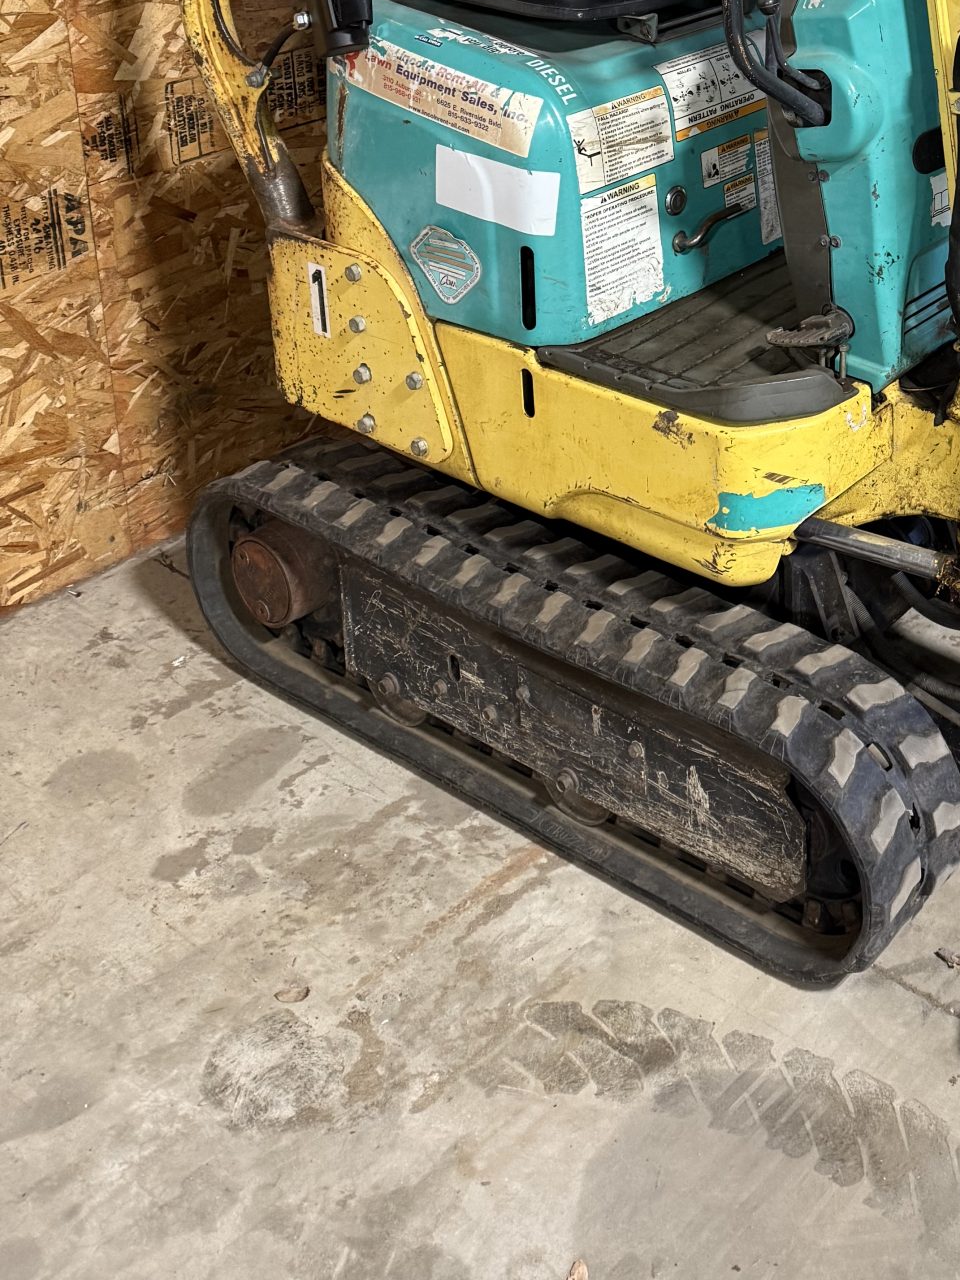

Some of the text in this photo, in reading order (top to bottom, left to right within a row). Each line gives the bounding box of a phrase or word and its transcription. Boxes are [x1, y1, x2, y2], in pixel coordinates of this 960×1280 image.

[294, 54, 307, 98] SIDE DOWN
[364, 53, 392, 71] Lawn
[395, 64, 457, 99] Equipment
[460, 91, 498, 116] Sales,
[525, 59, 577, 106] DIESEL
[436, 98, 503, 130] 6625 E. Riverside Blvd.
[597, 108, 629, 122] FALL HAZARD!
[617, 93, 646, 108] WARNING
[687, 93, 755, 124] OPERATING PATTERN
[174, 96, 189, 147] INSTALLATION
[184, 95, 197, 143] INFORMATION
[447, 110, 489, 132] 815-633-9322
[706, 113, 734, 128] WARNING
[607, 182, 640, 200] WARNING
[730, 175, 753, 190] WARNING
[603, 201, 629, 214] OPERATING
[628, 189, 656, 204] PROCEDURE:
[2, 205, 14, 247] THICKNESS
[13, 219, 24, 257] EXPOSURE
[22, 228, 30, 241] FOR
[62, 191, 90, 258] APA
[42, 224, 56, 270] SHEATHING
[311, 269, 328, 333] 1
